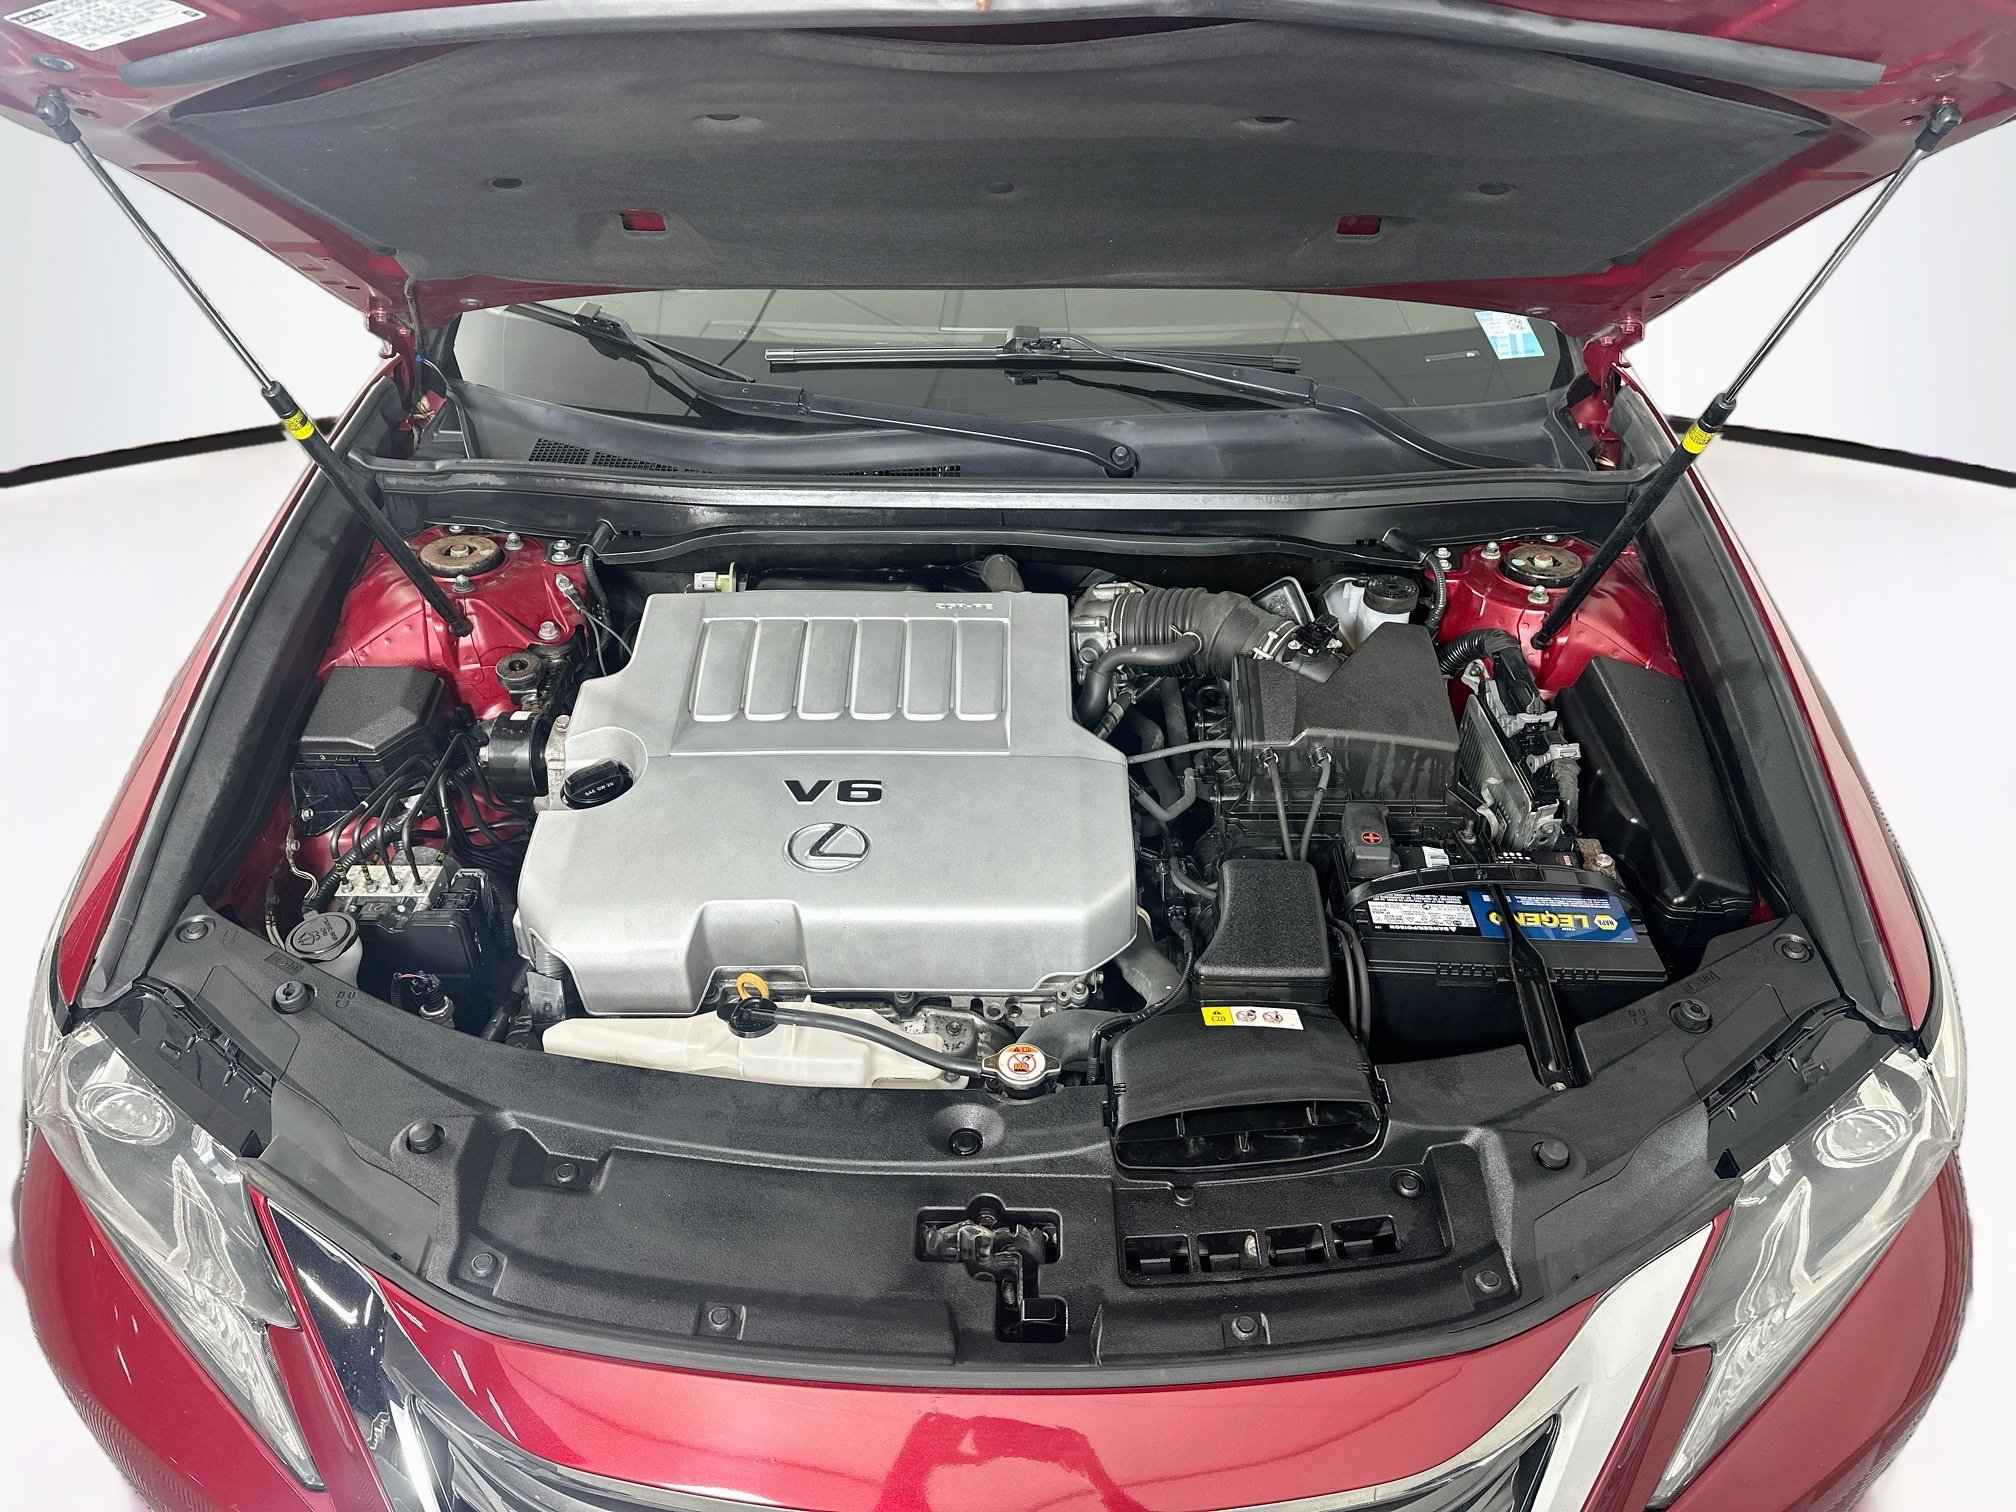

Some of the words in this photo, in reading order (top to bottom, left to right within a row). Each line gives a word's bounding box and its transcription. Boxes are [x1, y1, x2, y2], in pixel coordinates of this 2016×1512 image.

[584, 788, 597, 797] SAE
[782, 779, 884, 805] V6
[1595, 918, 1616, 927] NAPA
